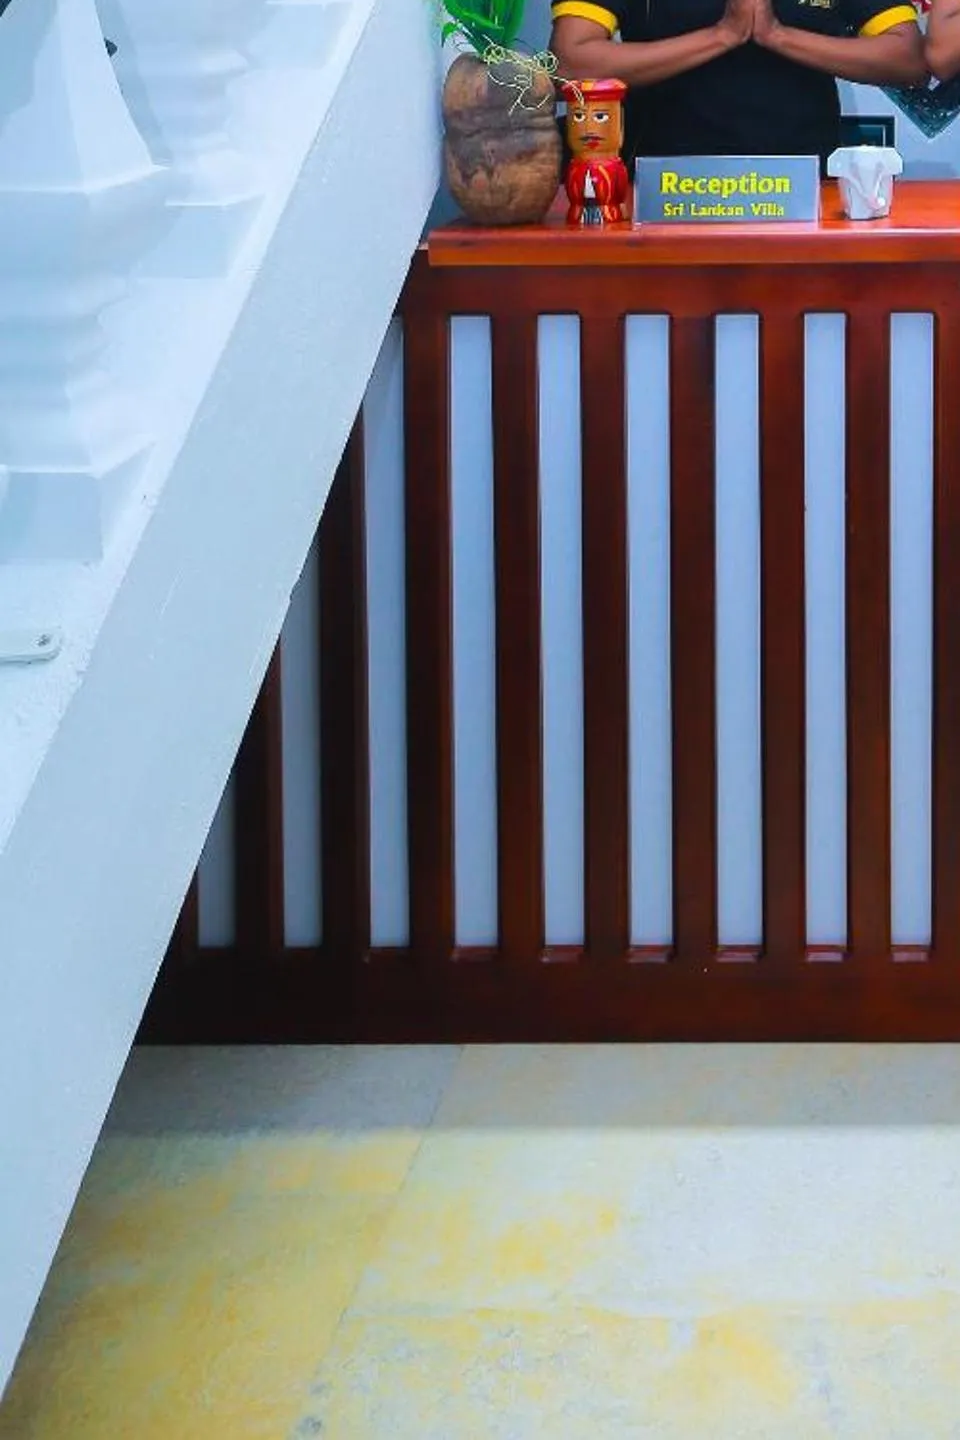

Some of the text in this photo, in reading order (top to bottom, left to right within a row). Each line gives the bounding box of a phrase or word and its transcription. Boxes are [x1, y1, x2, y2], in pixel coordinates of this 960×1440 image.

[660, 171, 791, 198] Reception
[663, 203, 785, 216] Sri Lankan Villa
